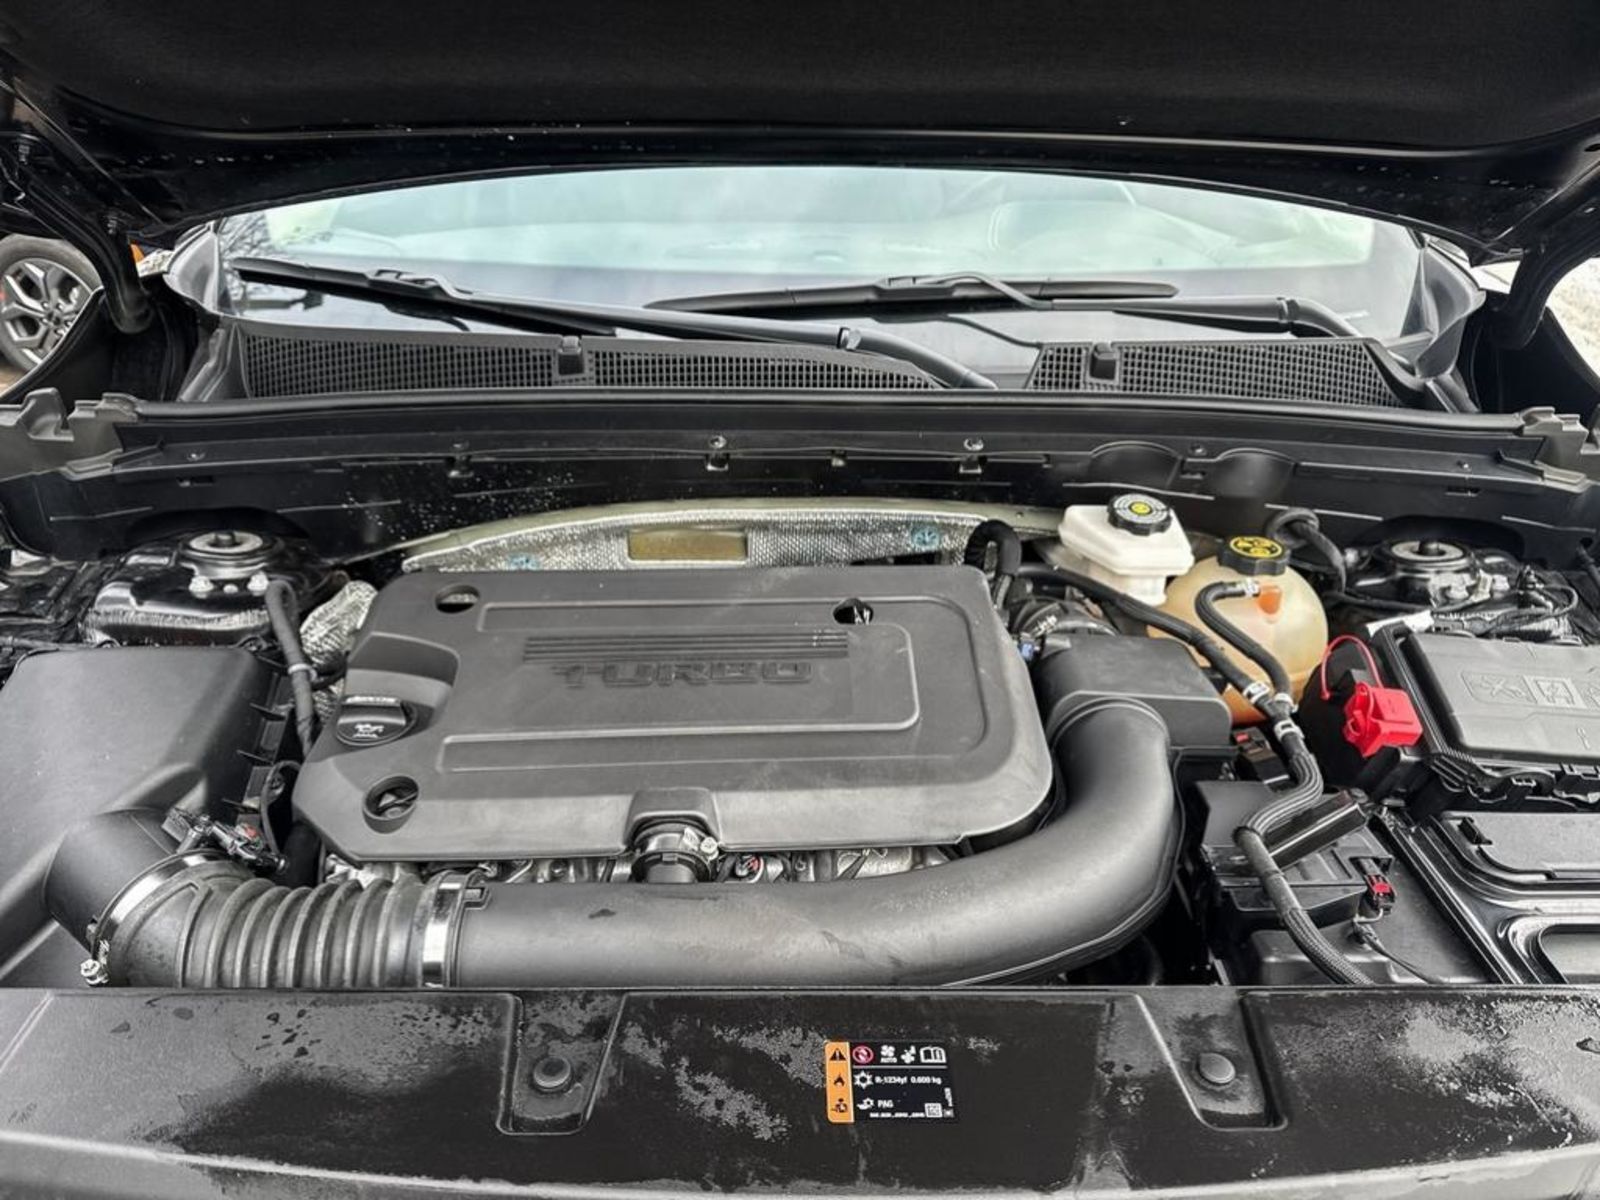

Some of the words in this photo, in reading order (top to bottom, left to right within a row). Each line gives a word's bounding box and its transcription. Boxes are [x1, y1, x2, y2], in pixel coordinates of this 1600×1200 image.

[552, 662, 812, 688] TURBO
[932, 1076, 942, 1085] kg
[877, 1099, 894, 1109] PAG
